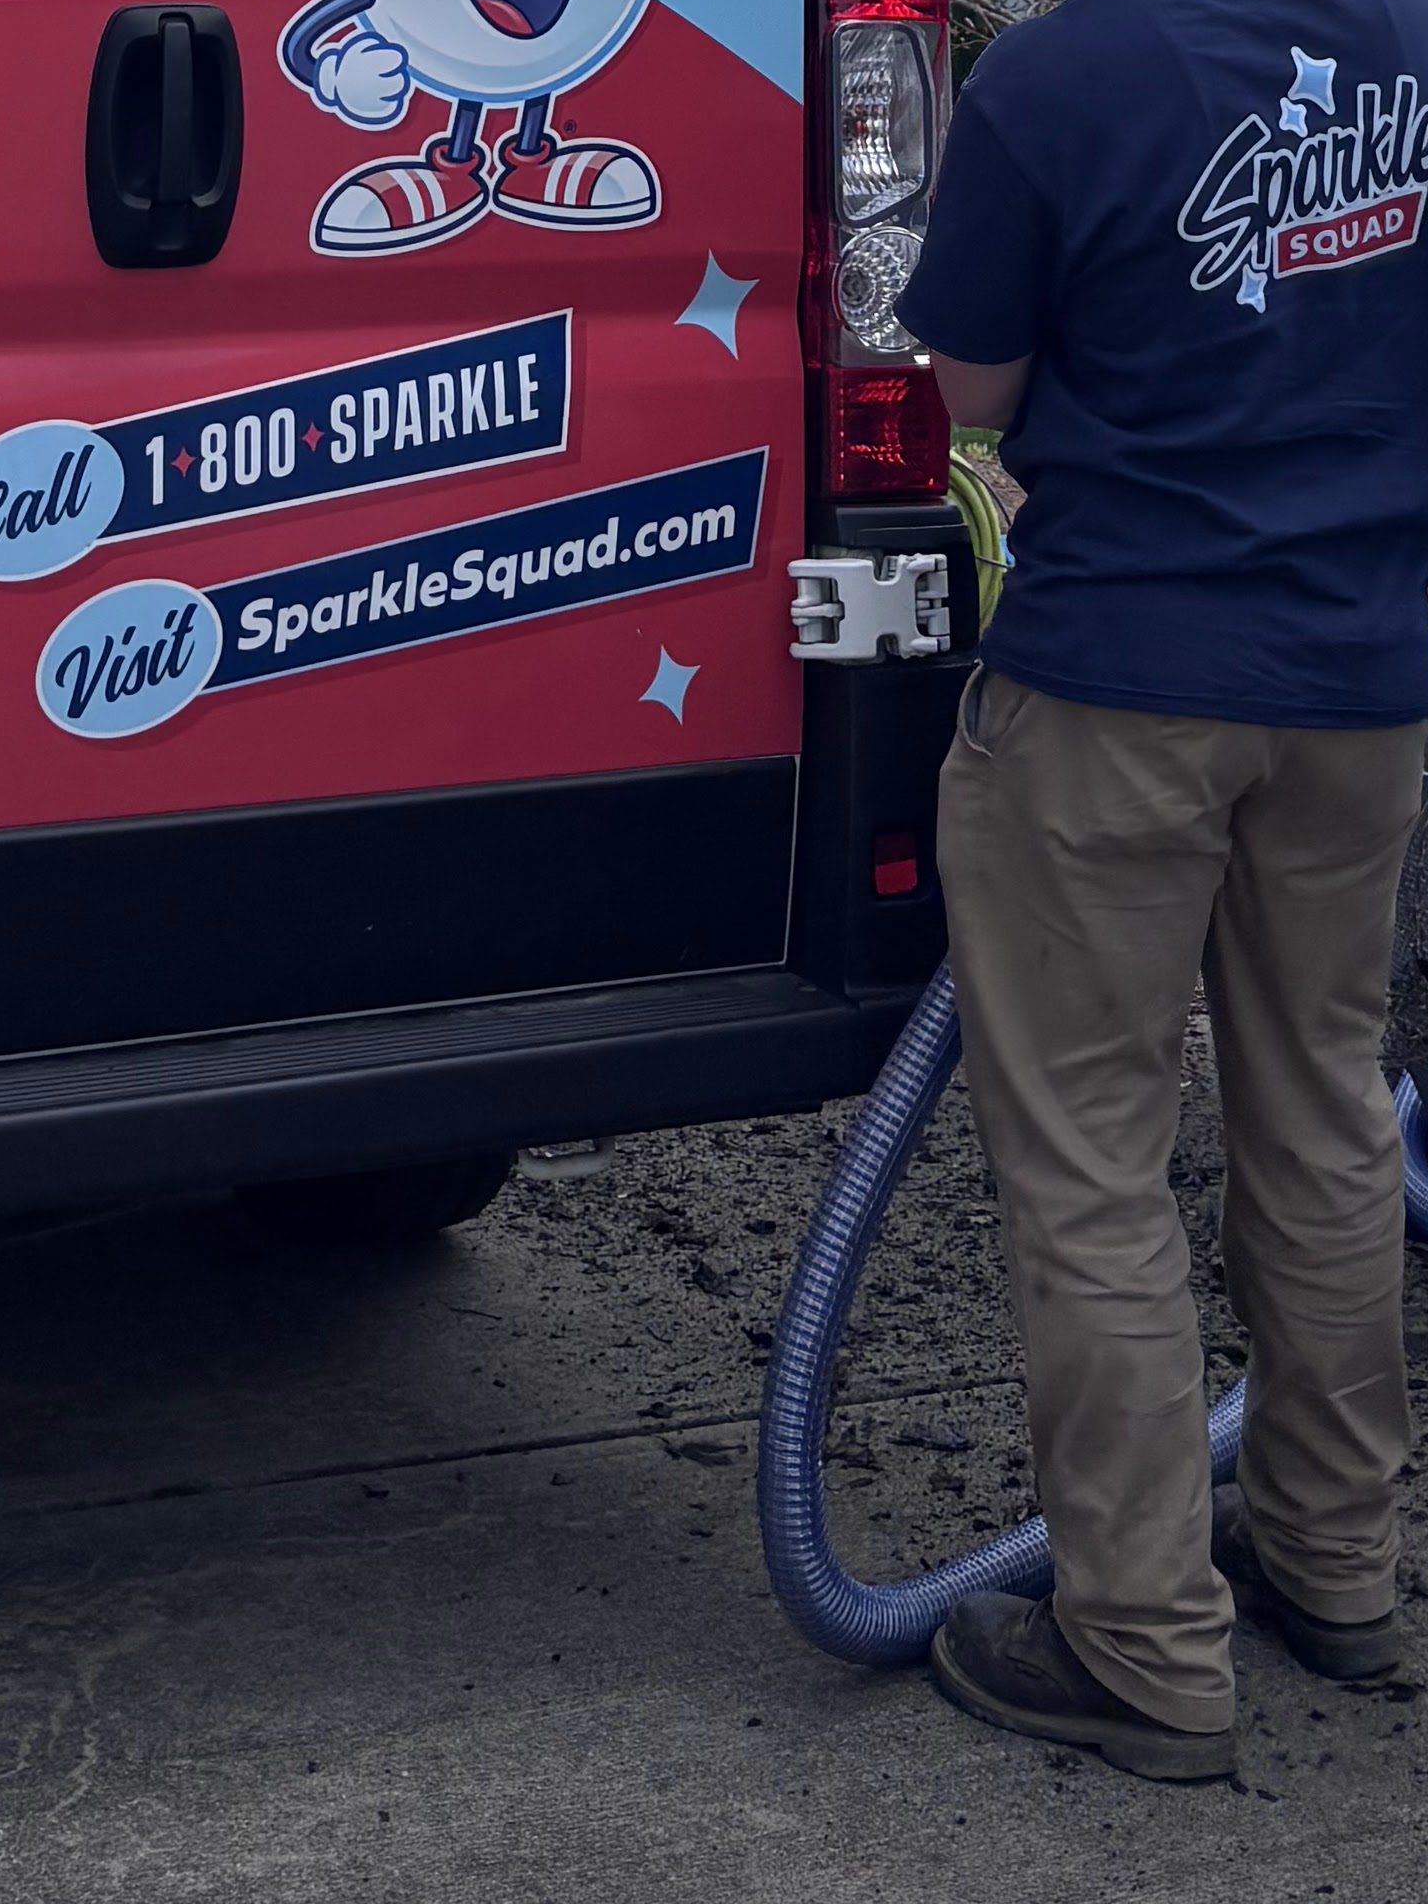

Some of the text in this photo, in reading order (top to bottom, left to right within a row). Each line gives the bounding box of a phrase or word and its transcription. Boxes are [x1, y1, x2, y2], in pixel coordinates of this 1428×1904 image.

[1289, 208, 1404, 260] SQUAD
[56, 501, 736, 719] Visit SparkleSquad.com
